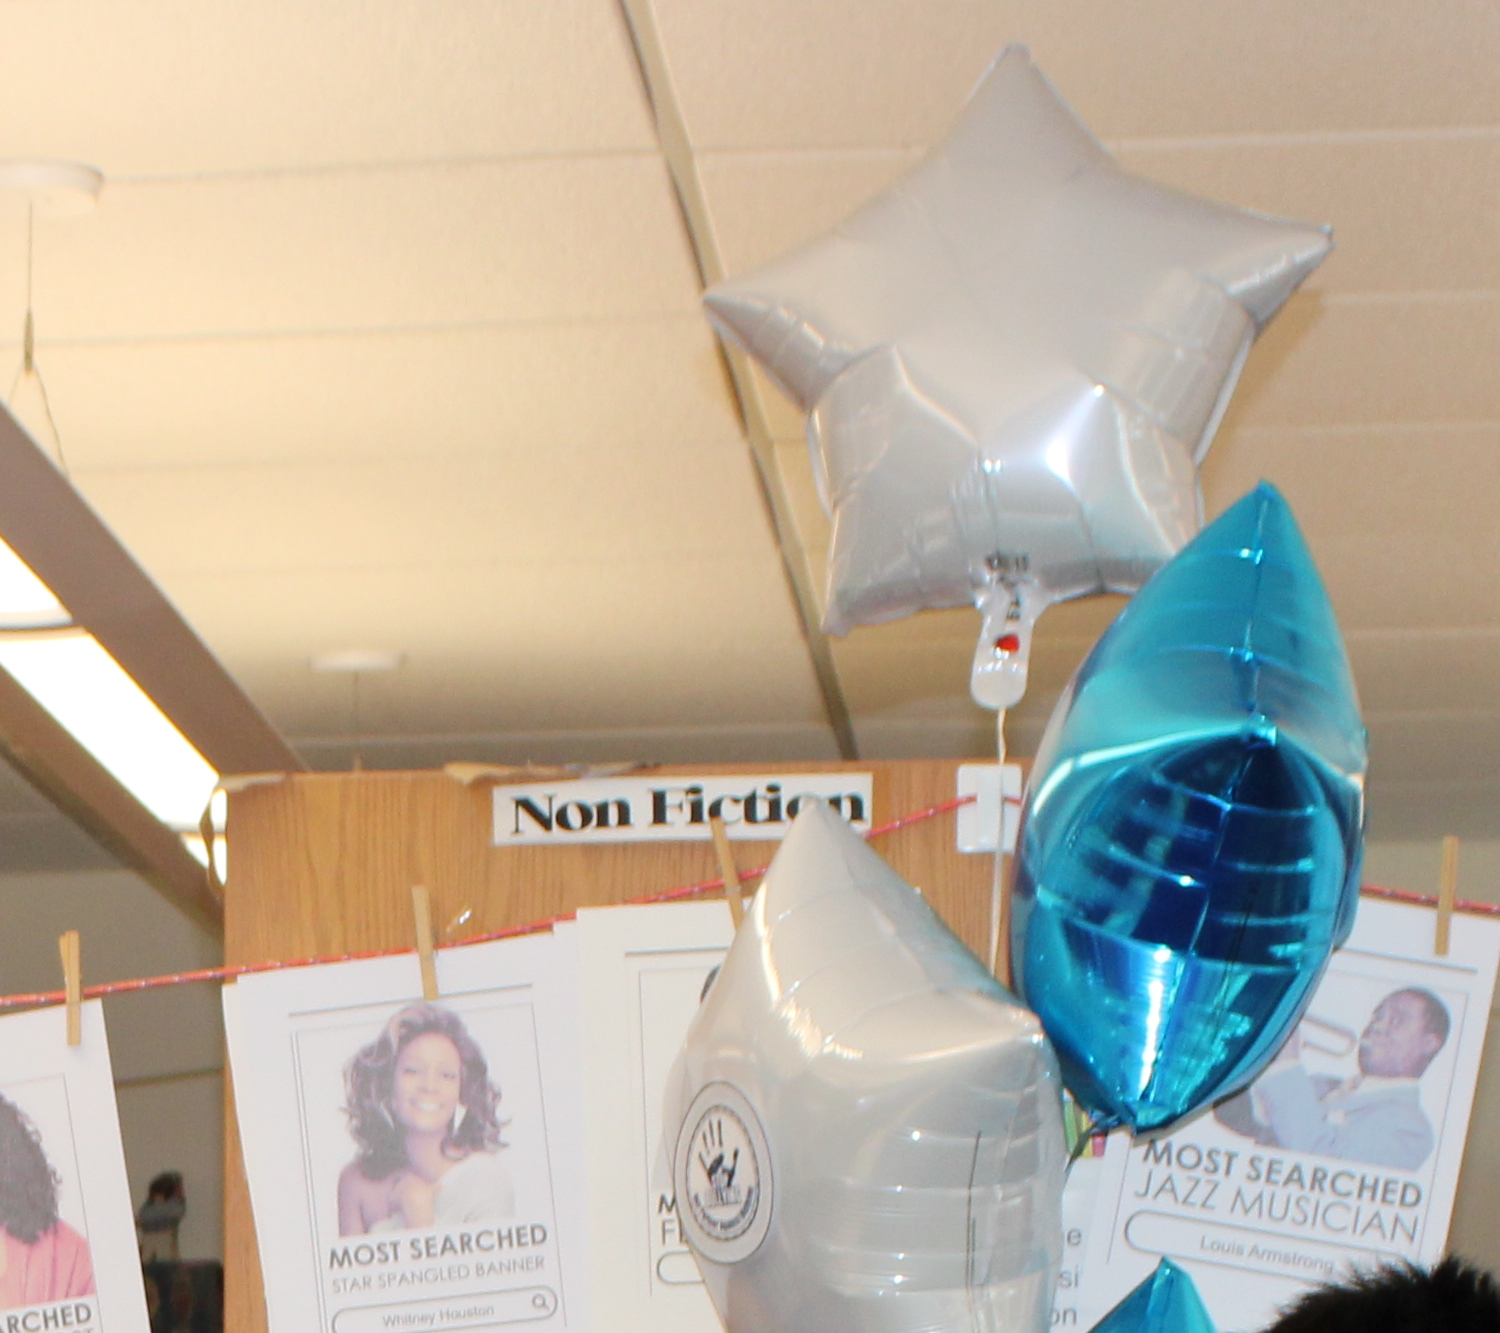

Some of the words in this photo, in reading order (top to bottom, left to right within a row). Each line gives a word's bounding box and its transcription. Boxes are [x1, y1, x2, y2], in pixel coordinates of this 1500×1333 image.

[511, 793, 634, 835] Non
[1143, 1139, 1239, 1178] MOST
[1246, 1154, 1421, 1208] SEARCHED
[1135, 1169, 1221, 1210] JAZZ
[1230, 1189, 1419, 1244] MUSICIAN
[329, 1240, 400, 1270] MOST
[410, 1223, 548, 1261] SEARCHED
[1200, 1235, 1244, 1256] Louis
[1248, 1246, 1333, 1273] Armstrong
[333, 1276, 371, 1294] STAR
[378, 1263, 469, 1288] SPANGLED
[476, 1255, 545, 1276] BANNER
[383, 1311, 435, 1328] Whitney
[440, 1306, 494, 1321] Houston
